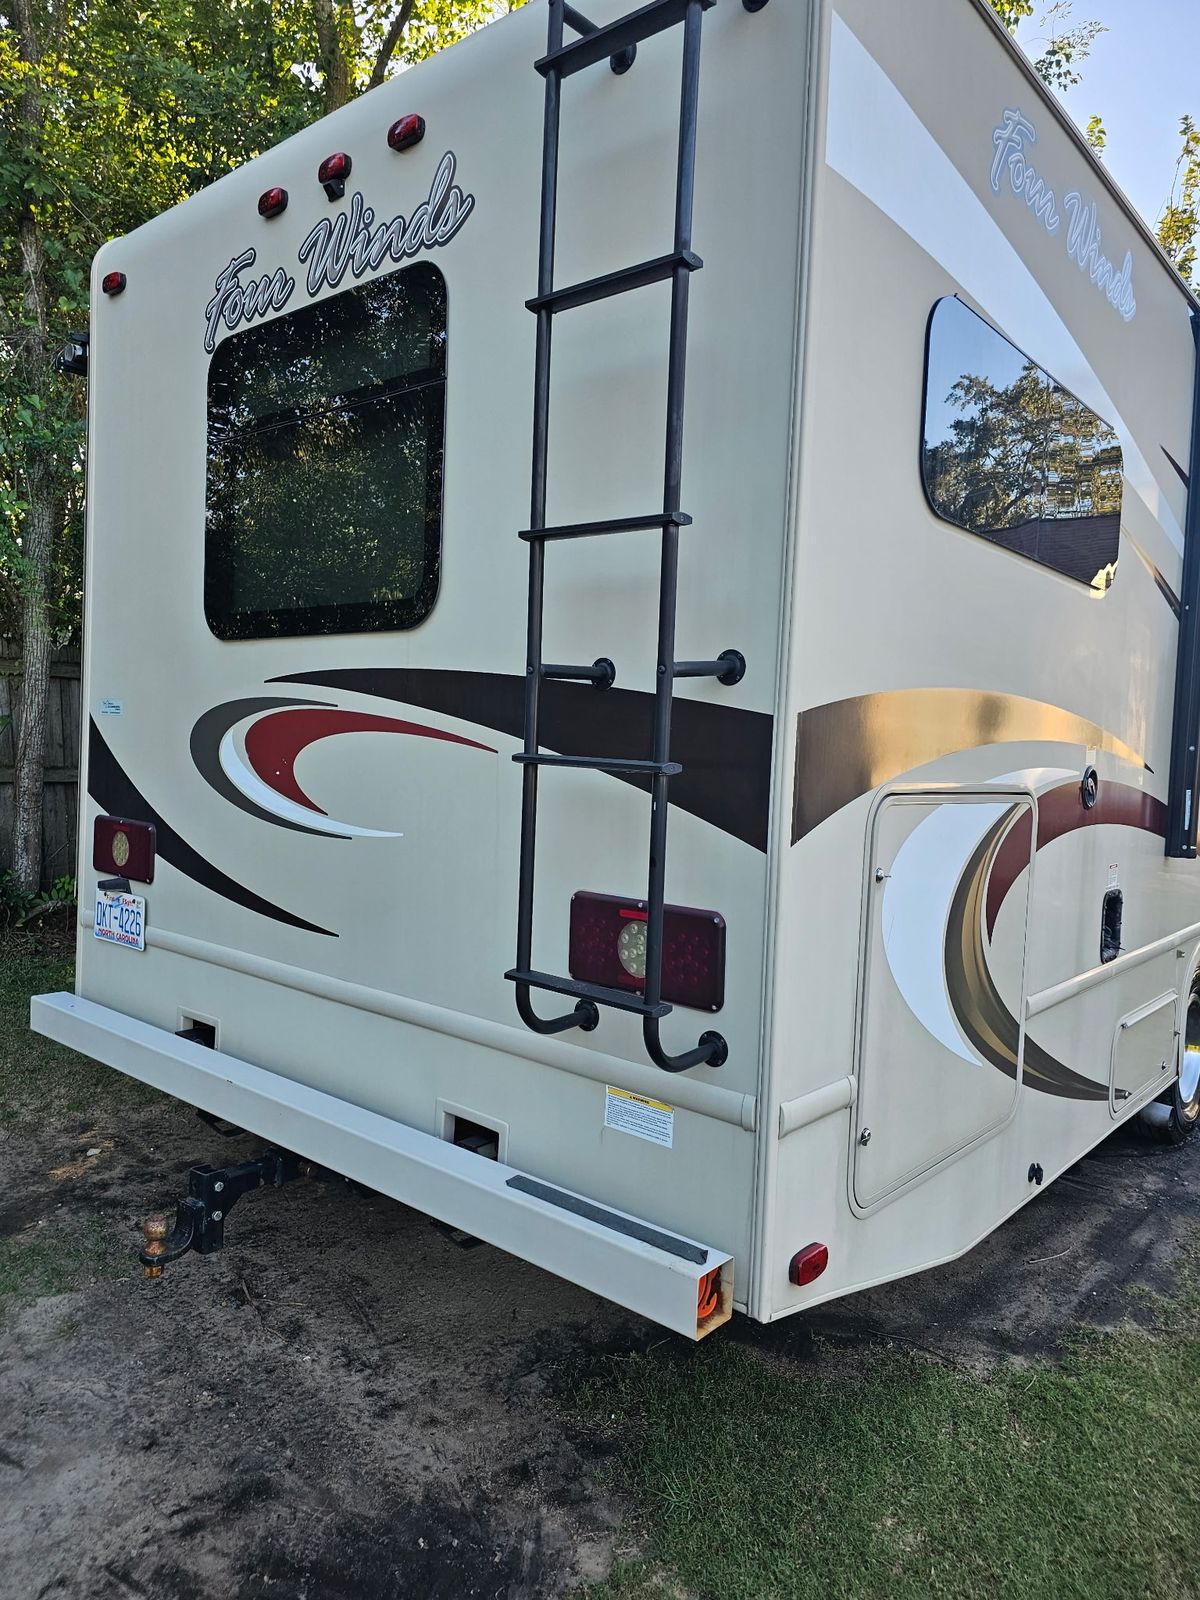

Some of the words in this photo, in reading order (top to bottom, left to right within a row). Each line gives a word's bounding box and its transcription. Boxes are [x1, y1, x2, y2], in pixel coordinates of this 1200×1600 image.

[203, 247, 296, 354] Four
[298, 151, 476, 298] Winds
[1063, 189, 1137, 323] Winds
[96, 901, 142, 937] DKT-4226
[98, 928, 115, 937] NORTH
[116, 932, 139, 944] CAROLINA
